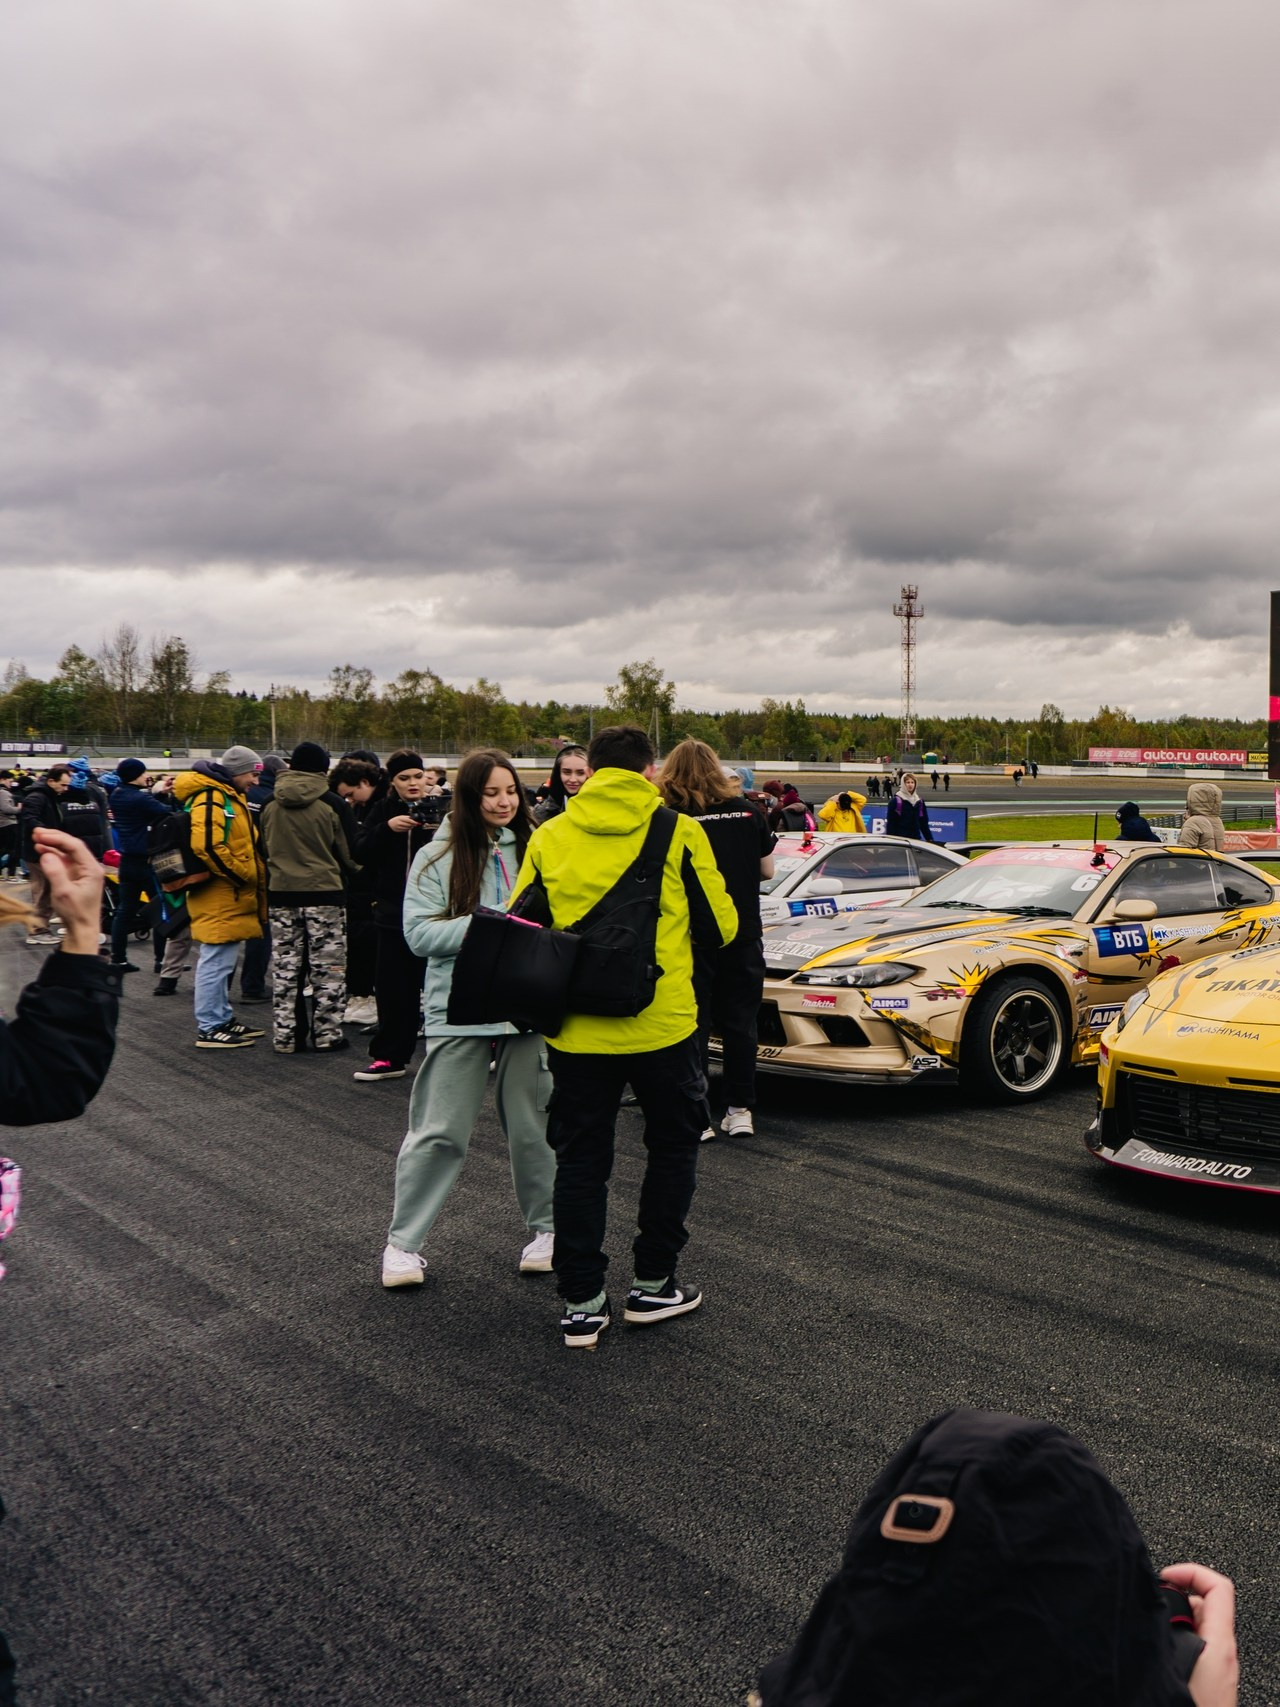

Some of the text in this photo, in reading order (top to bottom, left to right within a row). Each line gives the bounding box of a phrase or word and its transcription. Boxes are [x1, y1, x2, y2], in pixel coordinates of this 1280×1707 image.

[1143, 750, 1191, 761] auto.ru
[1196, 751, 1244, 762] auto.ru
[805, 902, 834, 917] ВТБ
[1154, 925, 1215, 939] MK KASHIYAMA
[1112, 930, 1144, 949] ВТБ
[1235, 992, 1264, 1000] MOTOR
[872, 999, 908, 1008] AIMOL
[1091, 1010, 1122, 1024] AIM
[1177, 1024, 1260, 1041] MK KASHIYAMA
[1132, 1149, 1253, 1179] FORWARDAUTO
